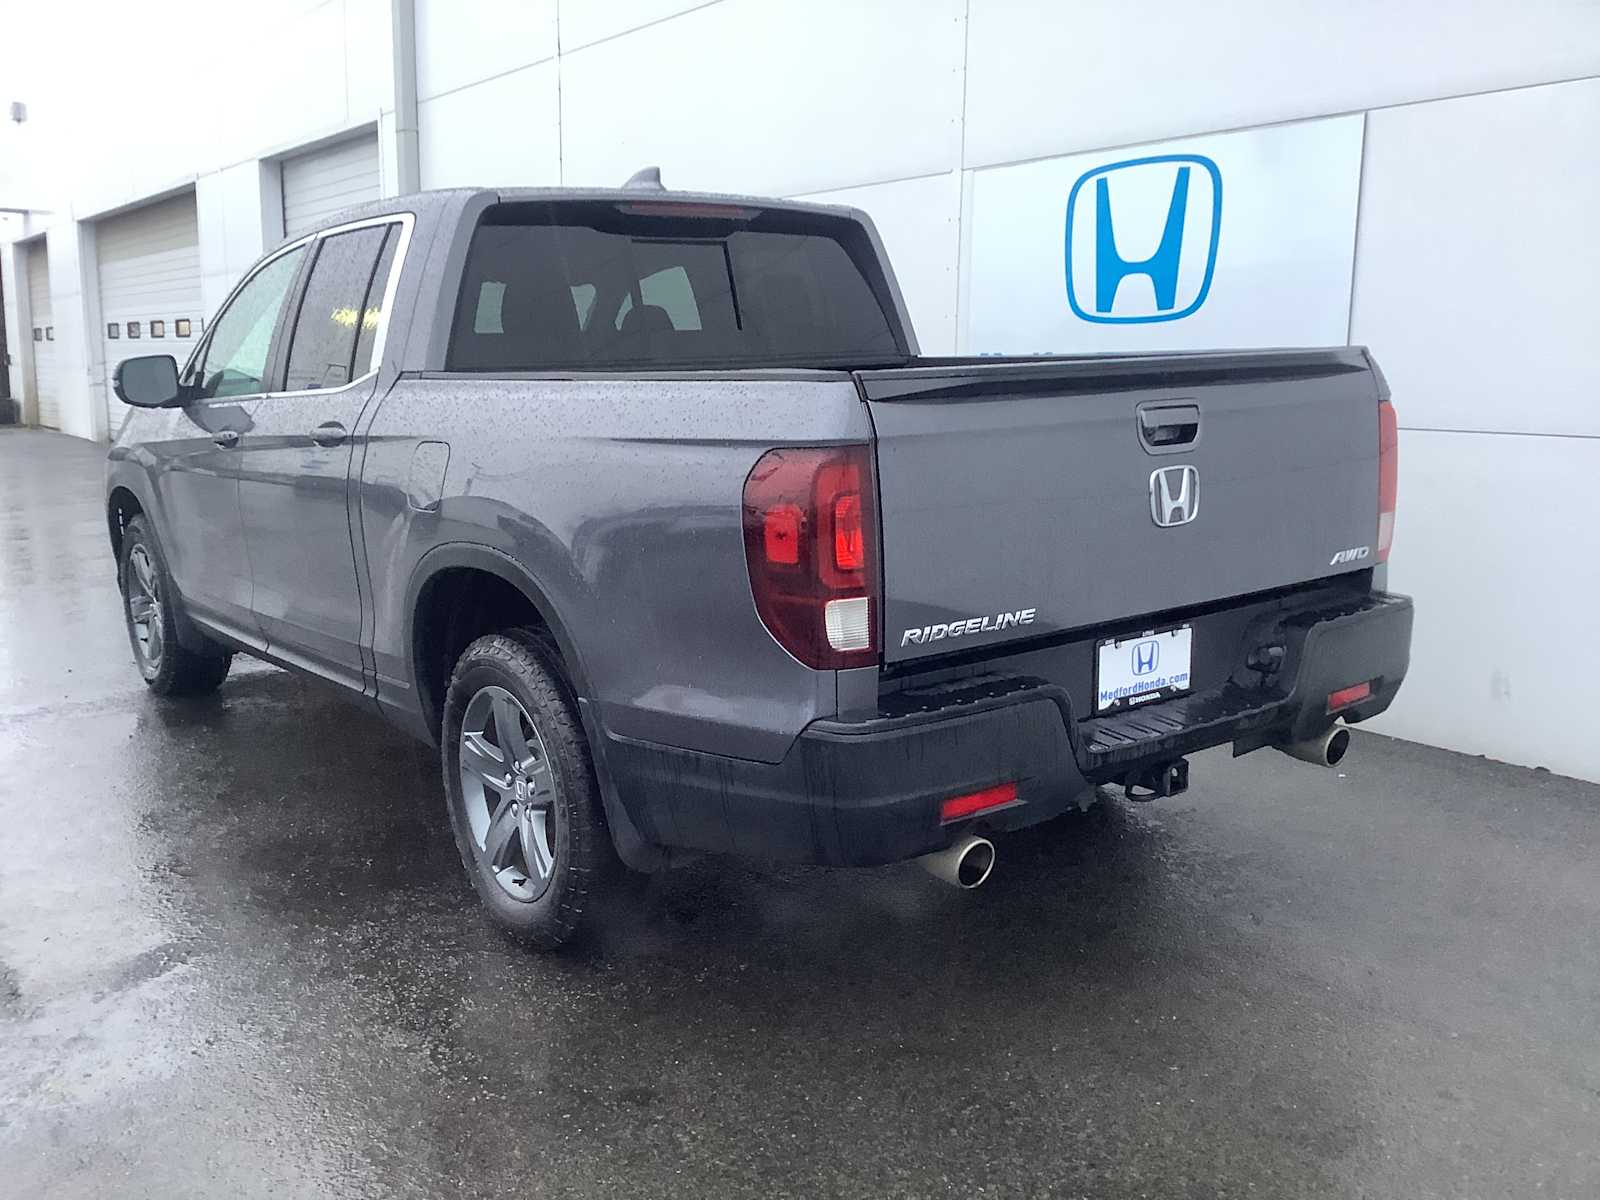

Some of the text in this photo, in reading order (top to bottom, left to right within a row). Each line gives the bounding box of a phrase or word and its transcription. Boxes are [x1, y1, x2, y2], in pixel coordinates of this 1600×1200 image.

[1329, 546, 1369, 566] AWD
[900, 607, 1037, 648] RIDGELINE
[1100, 672, 1188, 702] MedfordHonda.com
